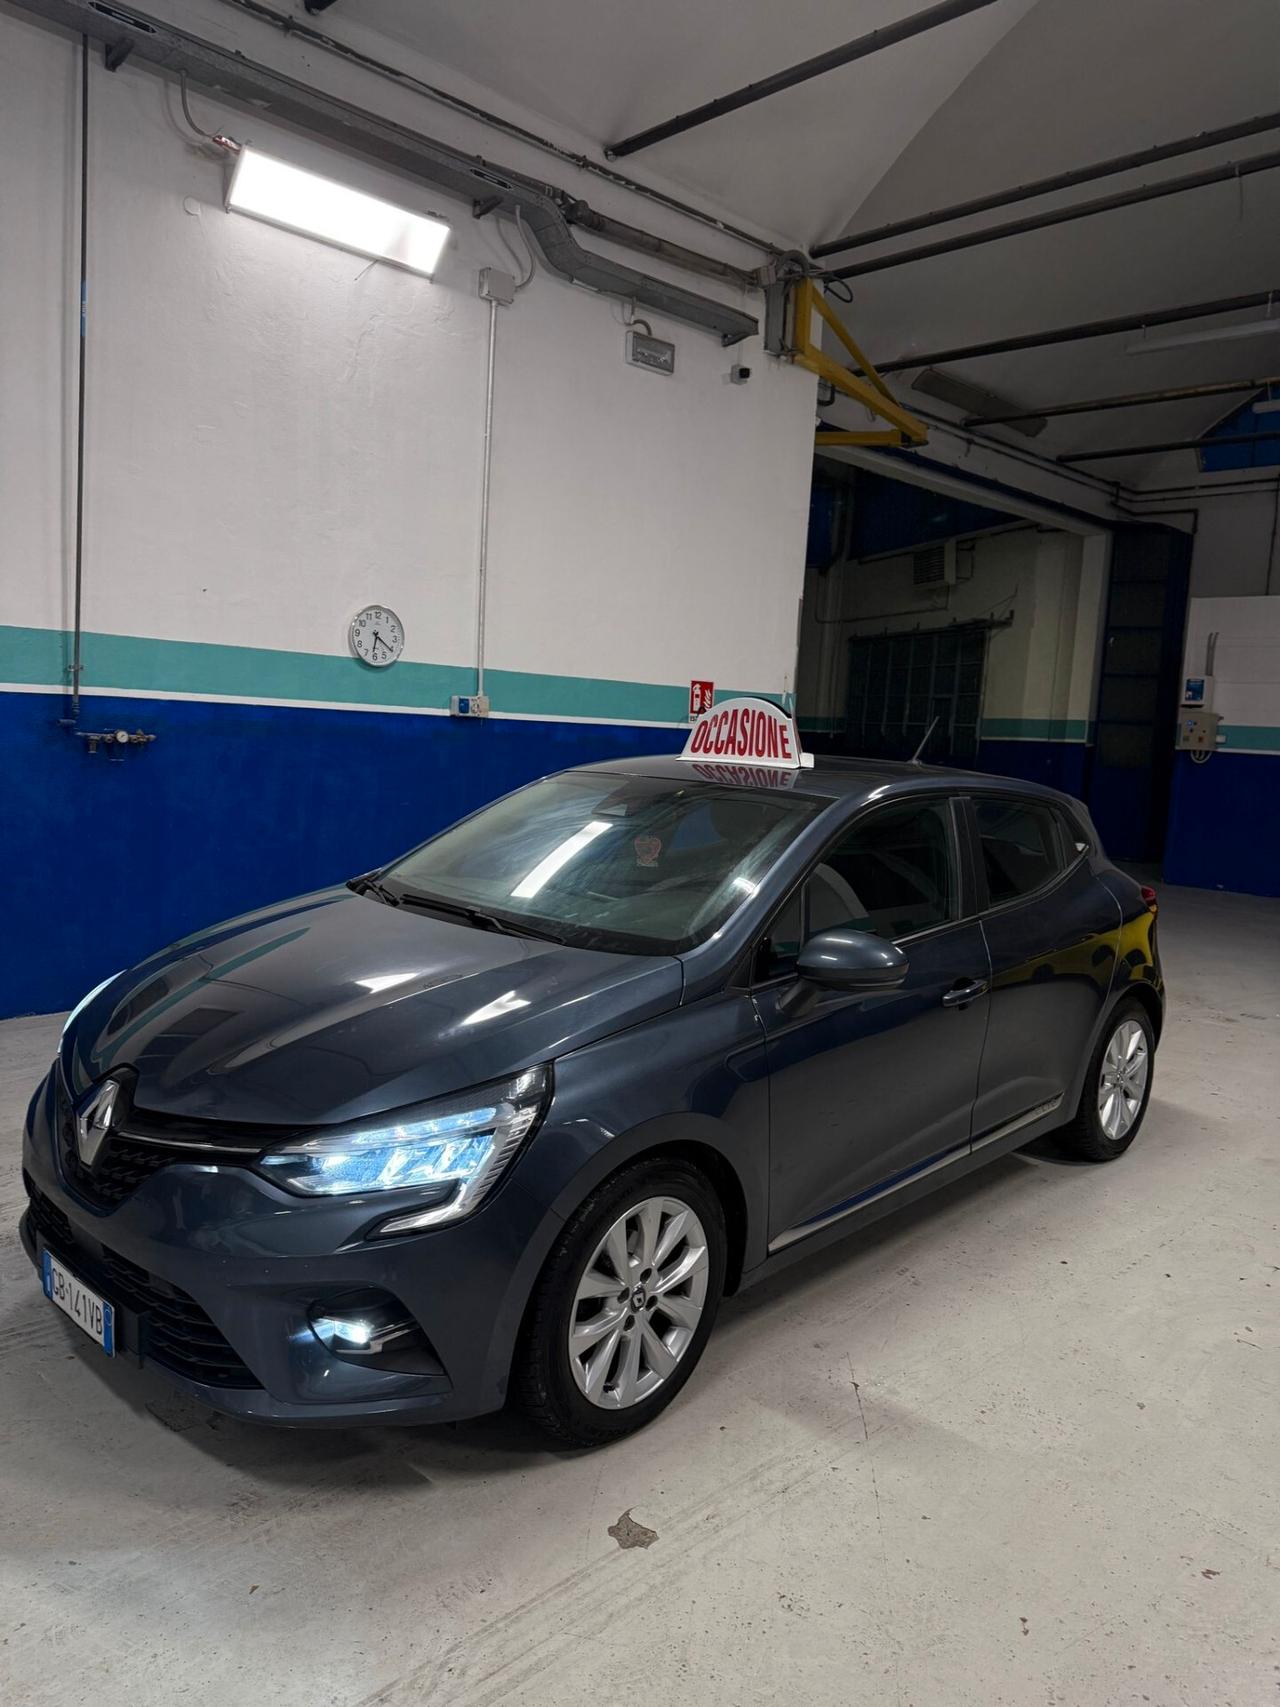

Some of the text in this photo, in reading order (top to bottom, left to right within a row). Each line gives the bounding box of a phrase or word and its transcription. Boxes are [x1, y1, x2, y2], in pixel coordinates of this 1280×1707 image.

[366, 613, 372, 621] 11
[374, 611, 382, 619] 12
[359, 619, 366, 627] 10
[355, 629, 361, 637] 9
[390, 625, 396, 633] 2
[392, 635, 397, 643] 3
[357, 640, 363, 648] 8
[364, 648, 369, 656] 7
[381, 651, 387, 659] 5
[372, 653, 378, 661] 6
[690, 708, 792, 759] OCCASIONE
